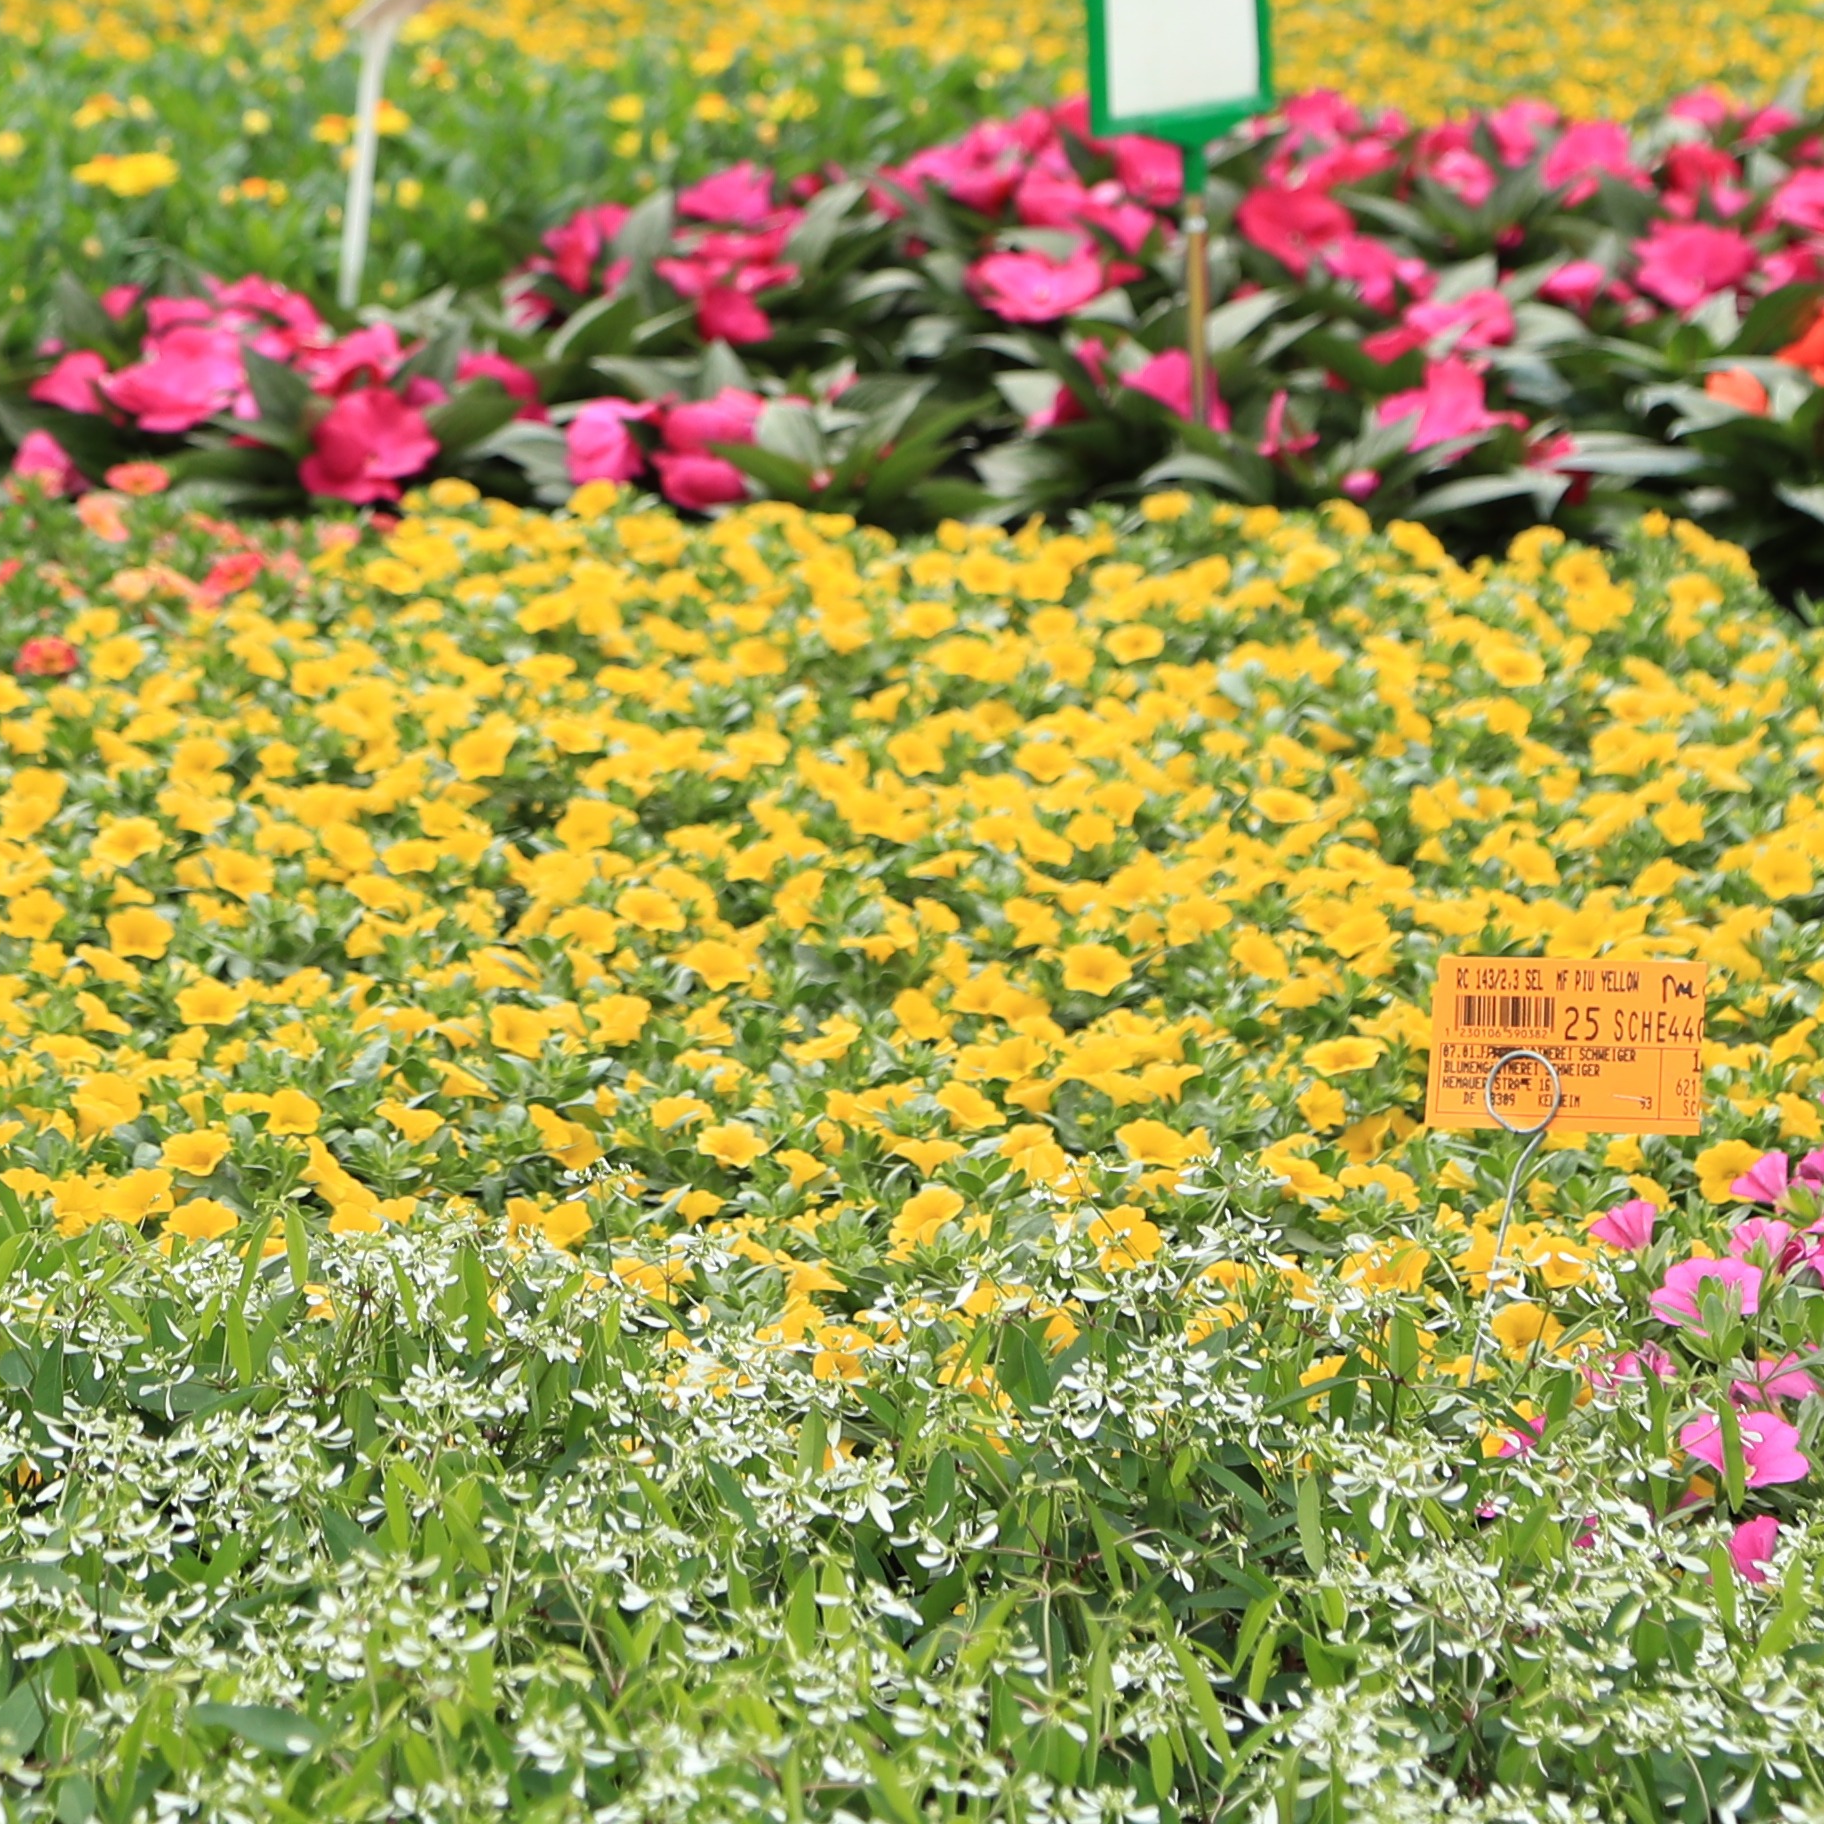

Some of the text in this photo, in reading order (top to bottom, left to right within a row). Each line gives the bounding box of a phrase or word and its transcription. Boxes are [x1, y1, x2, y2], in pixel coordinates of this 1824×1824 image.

[1456, 967, 1469, 989] RC
[1525, 969, 1544, 991] SEL
[1575, 970, 1594, 992] PIU
[1601, 970, 1640, 993] YELLOW
[1564, 1006, 1601, 1042] 25
[1579, 1048, 1636, 1062] SCHWEIGER
[1539, 1078, 1551, 1092] 16
[1463, 1091, 1476, 1105] DE
